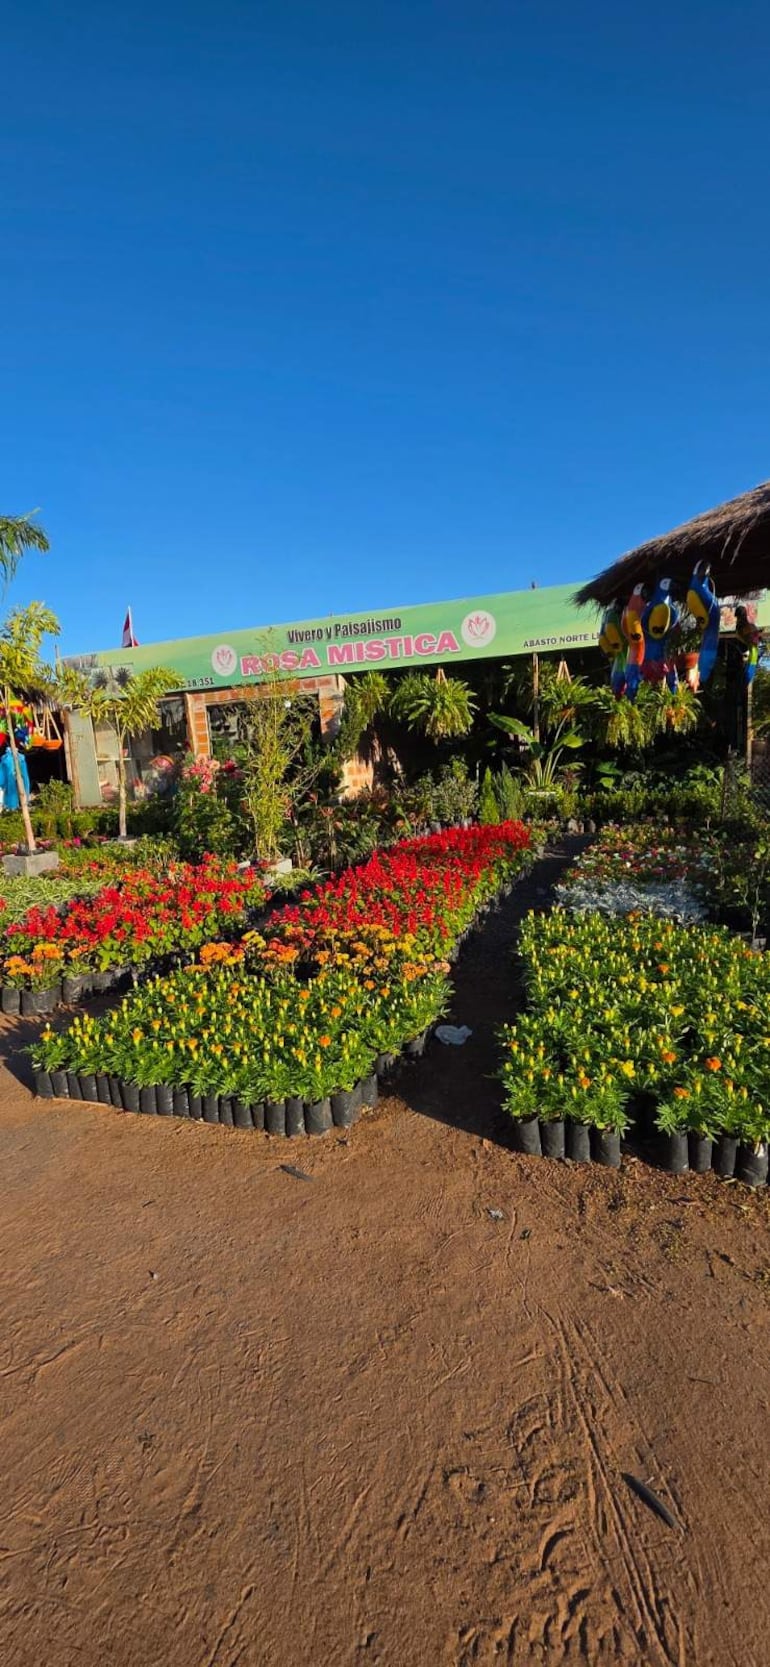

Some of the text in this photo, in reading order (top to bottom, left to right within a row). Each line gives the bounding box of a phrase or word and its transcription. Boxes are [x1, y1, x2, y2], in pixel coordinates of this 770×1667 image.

[288, 618, 401, 642] Vivero y Paisajismo
[523, 637, 557, 648] ABASTO
[559, 633, 589, 643] NORTE
[240, 632, 459, 676] ROSA MISTICA
